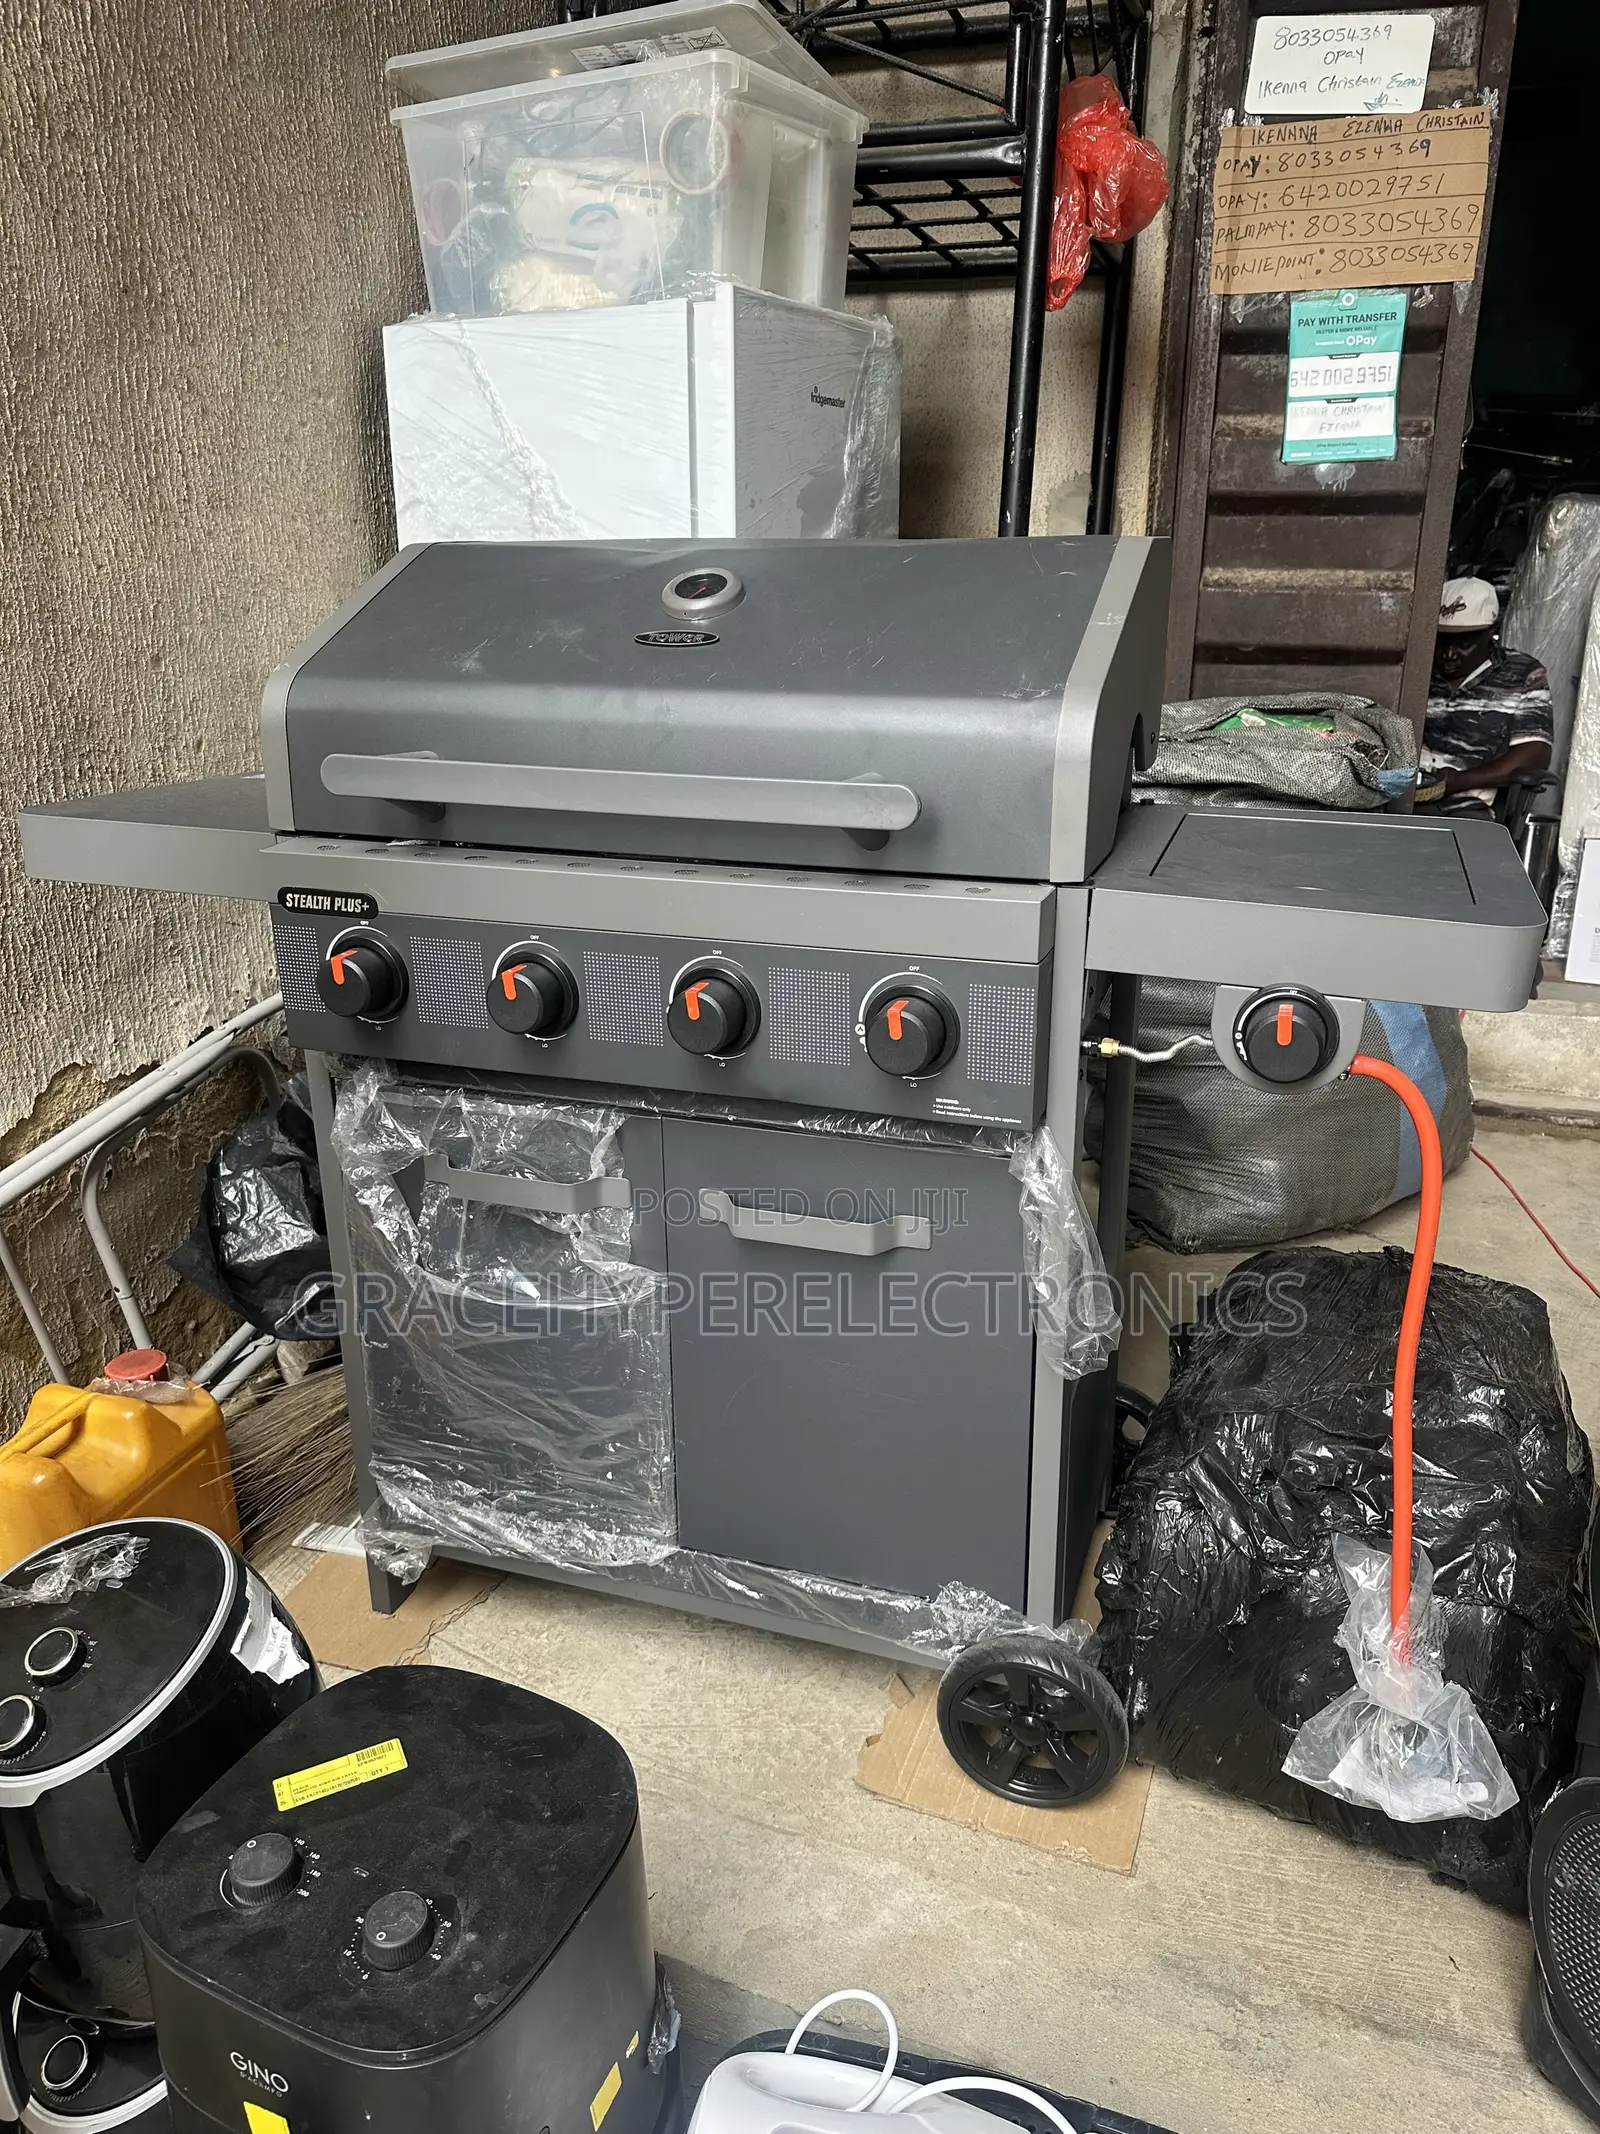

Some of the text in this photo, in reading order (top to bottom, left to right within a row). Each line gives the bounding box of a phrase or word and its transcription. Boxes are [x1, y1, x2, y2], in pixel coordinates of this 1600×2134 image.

[1416, 112, 1485, 132] CHRISTAIN
[1278, 138, 1432, 172] 8033054369
[1218, 173, 1445, 212] OPAY: 6420029751
[1304, 204, 1479, 238] 8033054369
[1329, 243, 1474, 273] 8033054369
[1298, 312, 1397, 327] PAY WITH TRANSFER
[1346, 335, 1377, 346] OPay
[811, 387, 845, 408] fridgemaster
[648, 633, 706, 643] TOWER
[286, 893, 370, 913] STEALTH PLUS+
[230, 2051, 289, 2093] GINO
